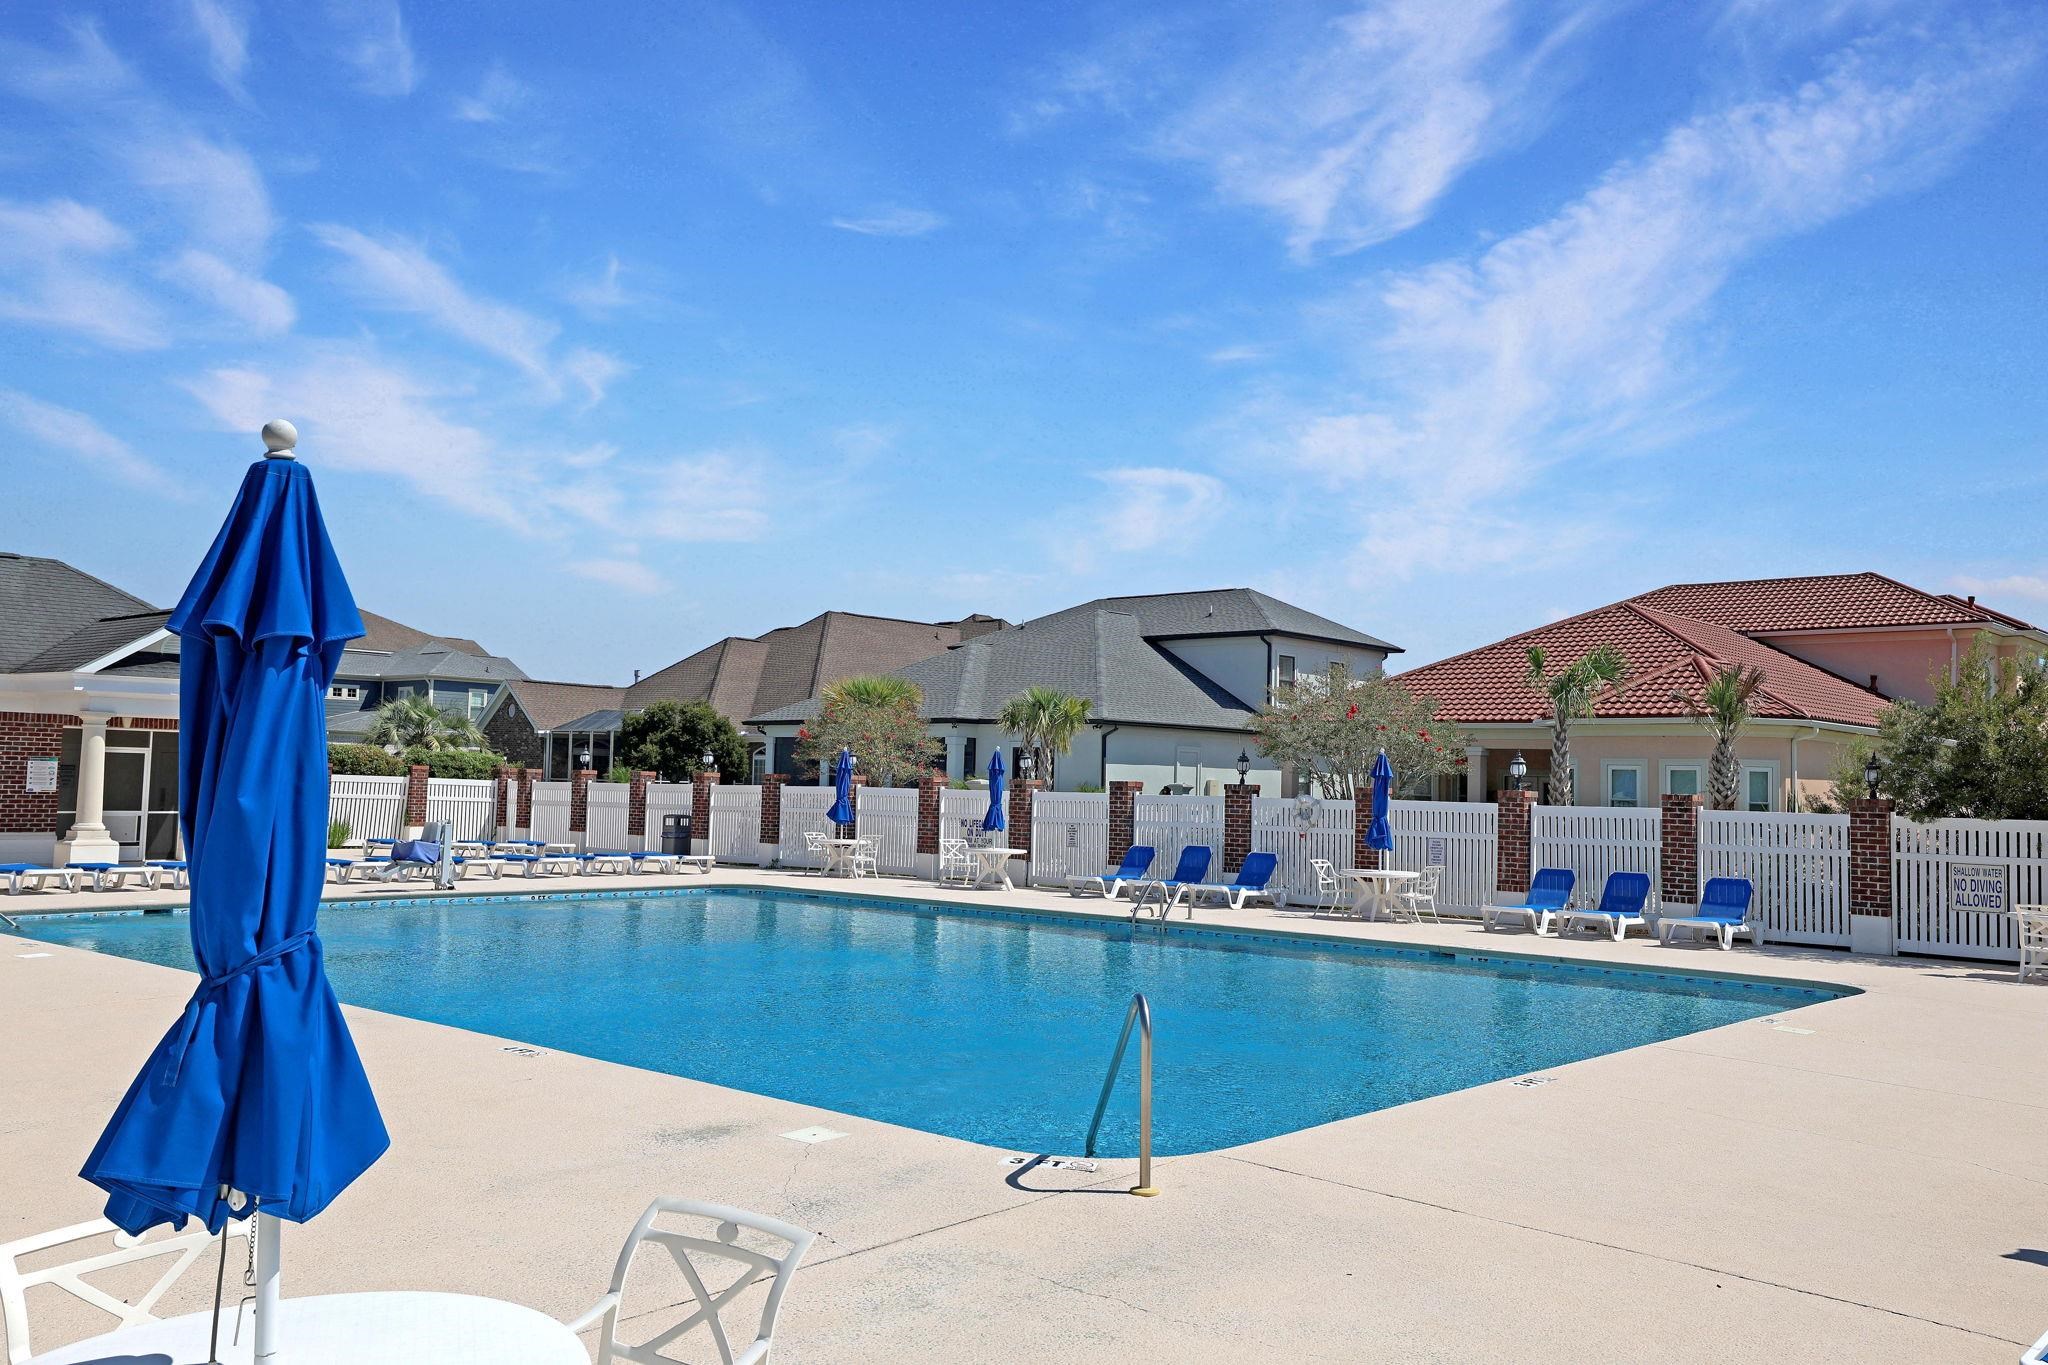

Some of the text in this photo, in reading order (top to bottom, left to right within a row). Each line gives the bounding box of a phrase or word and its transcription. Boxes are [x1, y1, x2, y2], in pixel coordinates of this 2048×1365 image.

[961, 819, 967, 828] NO
[967, 828, 973, 837] ON
[1953, 867, 2003, 878] SHALLOW WATER
[1953, 878, 2002, 894] NO DIVING
[1955, 893, 2002, 909] ALLOWED
[1035, 1159, 1066, 1168] FT
